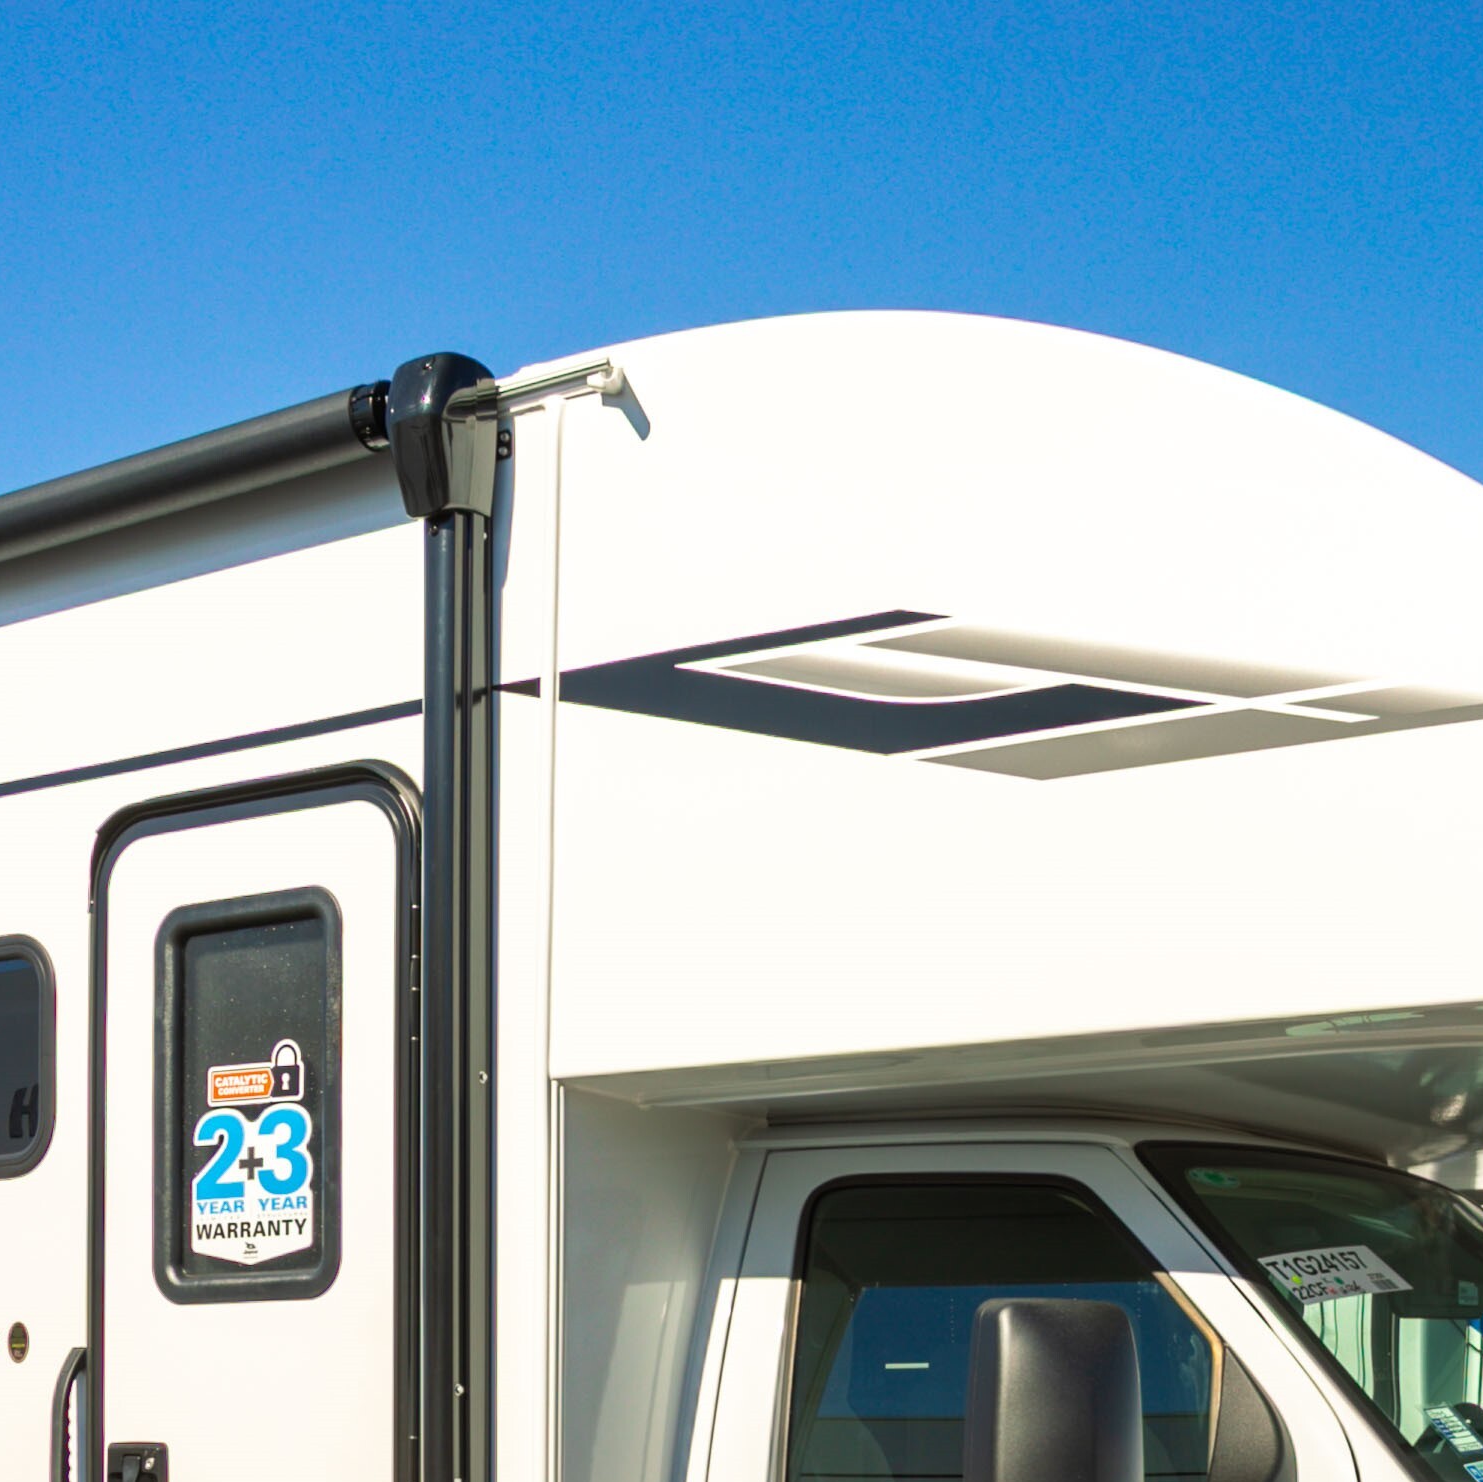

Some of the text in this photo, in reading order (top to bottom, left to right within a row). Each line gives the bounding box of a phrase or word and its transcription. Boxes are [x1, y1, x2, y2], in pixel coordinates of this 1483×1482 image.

[214, 1073, 269, 1087] CATALYTIC
[218, 1084, 265, 1096] CONVERTER
[196, 1200, 245, 1215] YEAR
[257, 1195, 308, 1212] YEAR
[196, 1217, 307, 1241] WARRANTY
[1265, 1251, 1368, 1281] T1G24157
